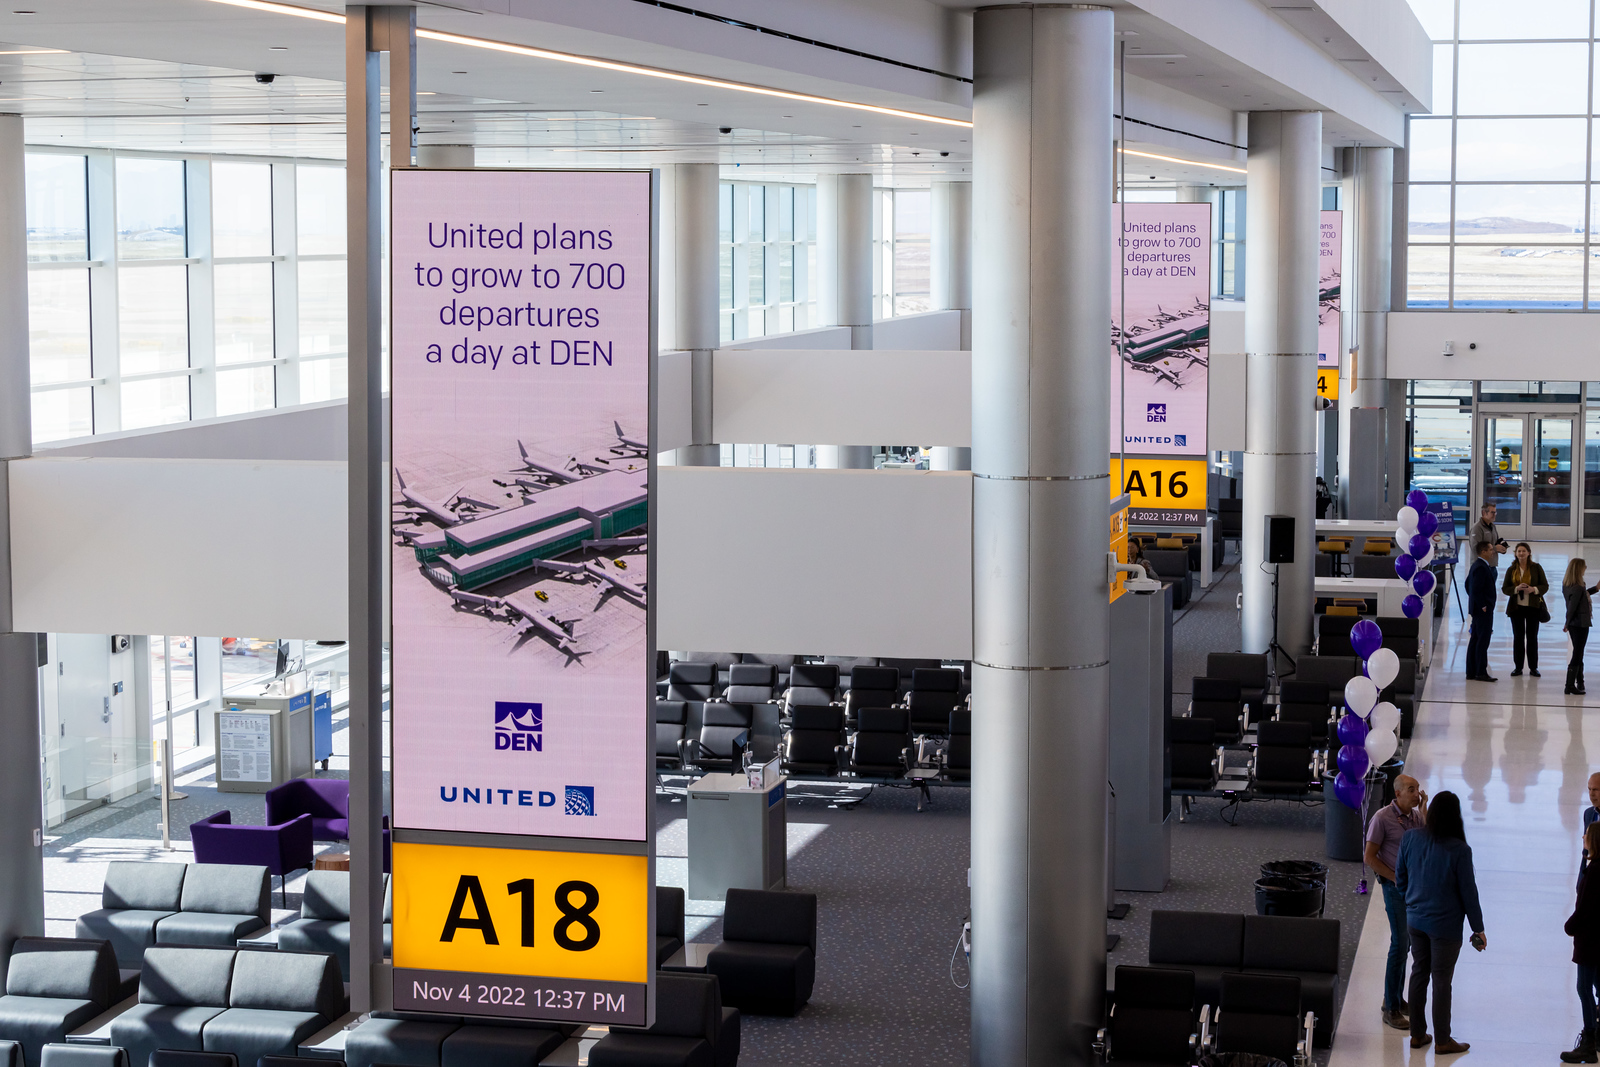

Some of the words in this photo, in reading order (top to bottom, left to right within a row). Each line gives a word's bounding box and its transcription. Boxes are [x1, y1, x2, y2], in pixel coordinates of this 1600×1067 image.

[428, 222, 523, 249] United
[533, 222, 613, 255] plans
[1123, 222, 1161, 233] United
[1164, 222, 1197, 235] plans
[1321, 231, 1336, 239] 700
[1118, 237, 1130, 248] to
[1132, 239, 1161, 250] grow
[1164, 237, 1176, 248] to
[1178, 236, 1201, 248] 700
[1127, 251, 1191, 264] departures
[414, 262, 443, 287] to
[451, 266, 523, 294] grow
[531, 263, 560, 289] to
[569, 262, 625, 290] 700
[1123, 267, 1129, 276] a
[1131, 265, 1153, 278] day
[1155, 266, 1167, 276] at
[1171, 265, 1196, 277] DEN
[439, 298, 600, 332] departures
[425, 343, 442, 363] a
[451, 337, 503, 370] day
[511, 340, 541, 365] at
[550, 339, 613, 367] DEN
[1125, 436, 1172, 444] UNITED
[1124, 470, 1188, 499] A16
[1131, 512, 1137, 520] 4
[1139, 512, 1159, 520] 2022
[1161, 513, 1182, 521] 12:37
[1184, 513, 1198, 522] PM
[495, 732, 543, 752] DEN
[440, 786, 556, 807] UNITED
[439, 874, 601, 952] A18
[413, 981, 453, 1001] Nov
[458, 984, 472, 1003] 4
[477, 985, 526, 1007] 2022
[533, 988, 586, 1010] 12:37
[593, 992, 625, 1013] PM
